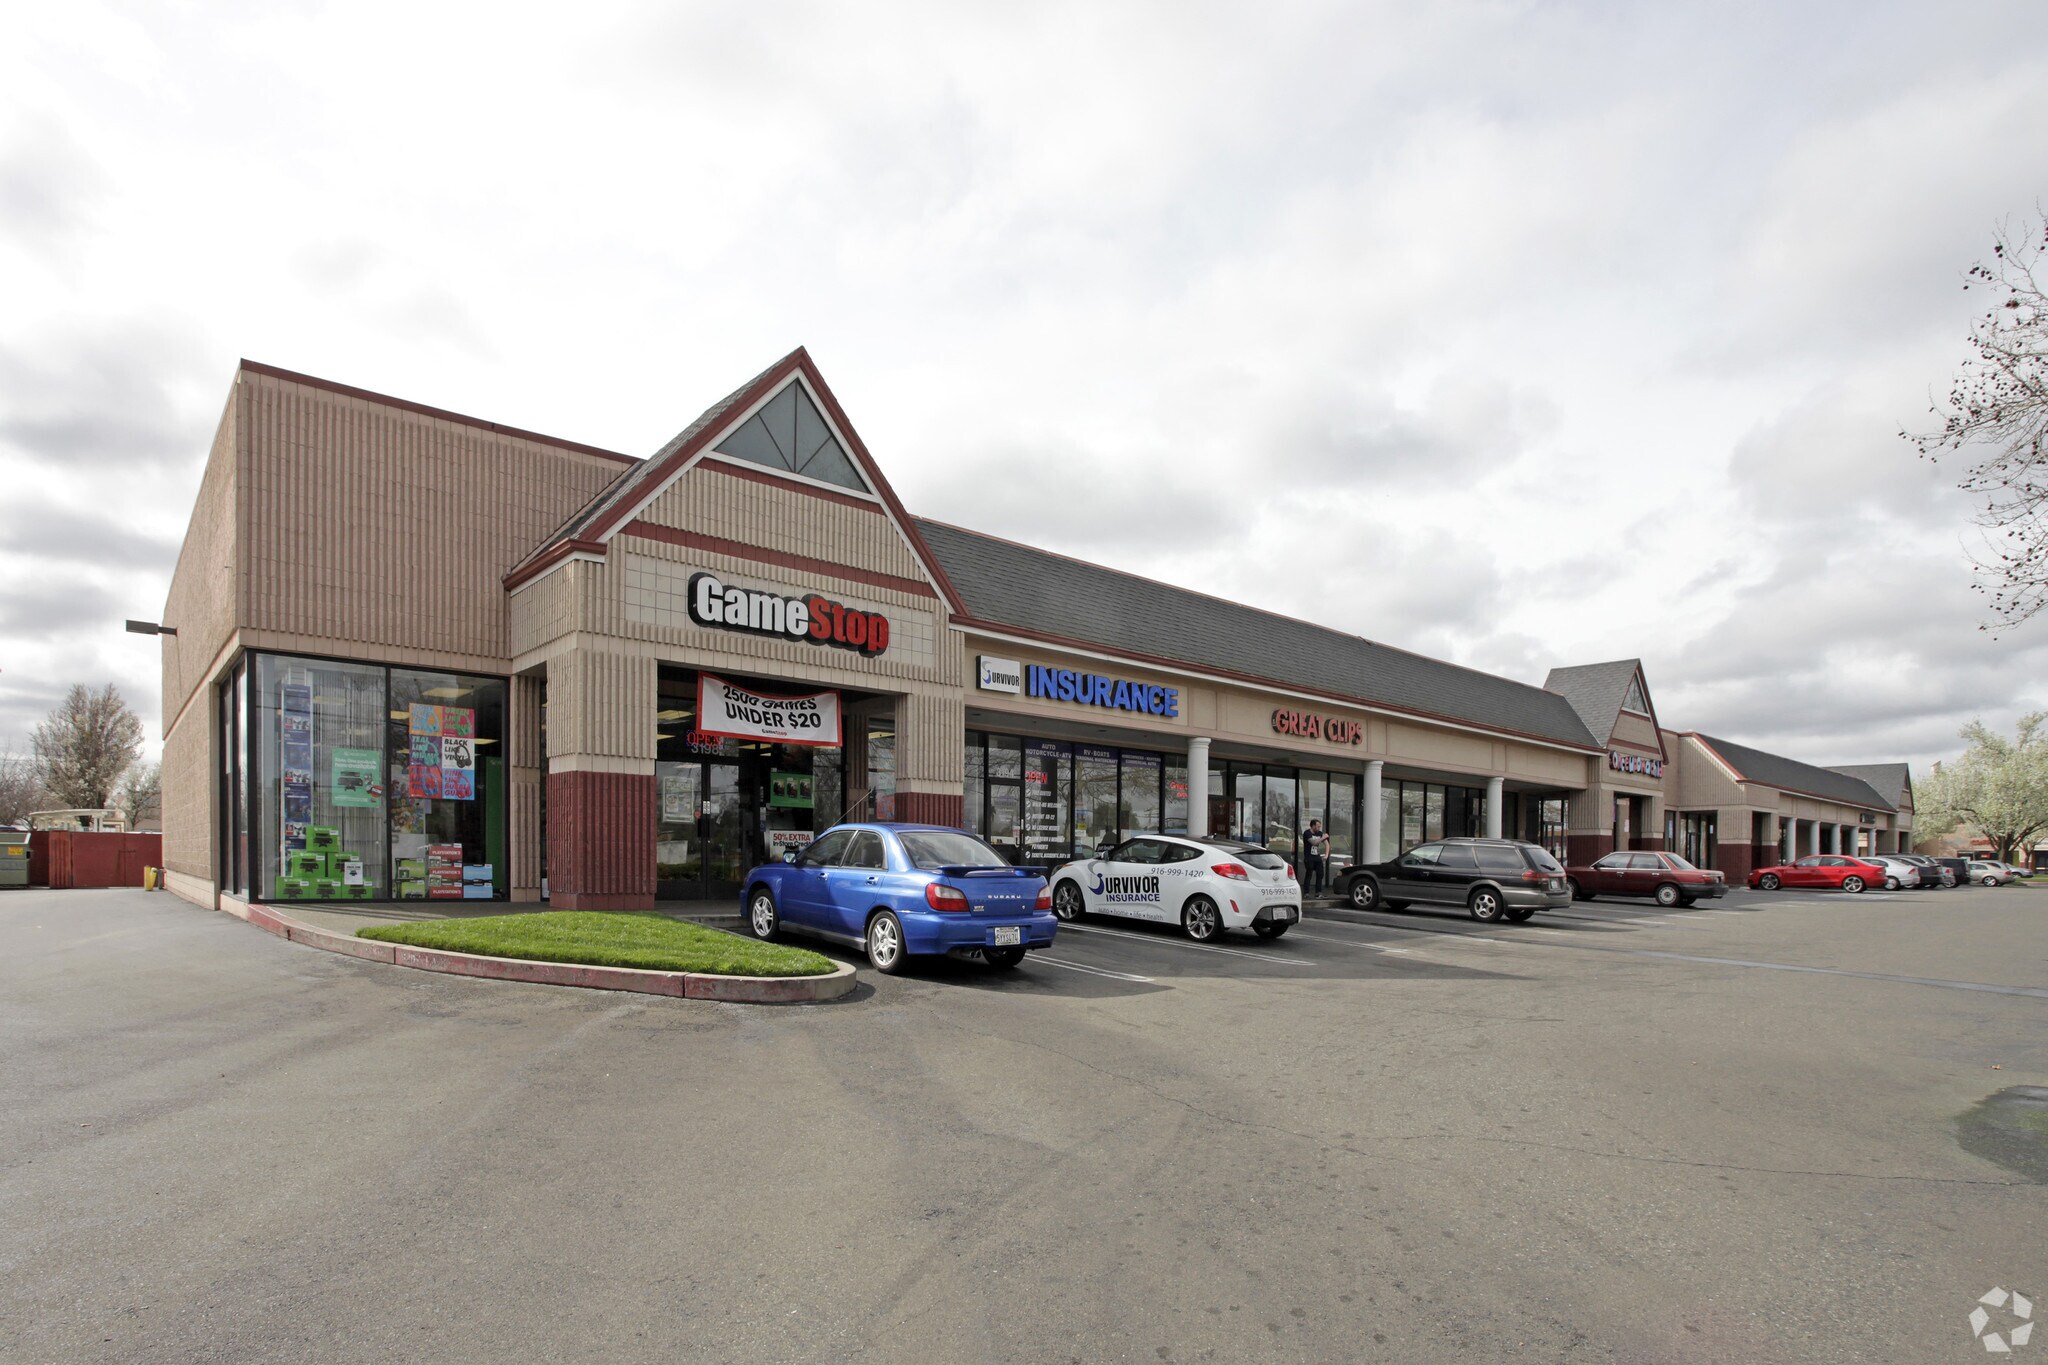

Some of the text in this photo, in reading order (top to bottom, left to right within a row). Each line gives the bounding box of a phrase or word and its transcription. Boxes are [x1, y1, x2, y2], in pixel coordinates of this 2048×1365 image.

[697, 577, 889, 651] GameStop
[1028, 664, 1179, 718] INSURANCE
[725, 702, 822, 730] UNDER $20
[1275, 708, 1364, 745] GREAT CLIPS
[444, 738, 468, 746] BLACK
[1025, 748, 1060, 757] MOTORCYCLE
[1025, 771, 1048, 784] OPEN
[773, 833, 811, 841] 50% EXTRA
[1150, 867, 1204, 878] 916-999-1420
[1260, 887, 1297, 896] 916-999-1420
[1106, 893, 1161, 902] INSURANCE
[1146, 913, 1164, 921] health
